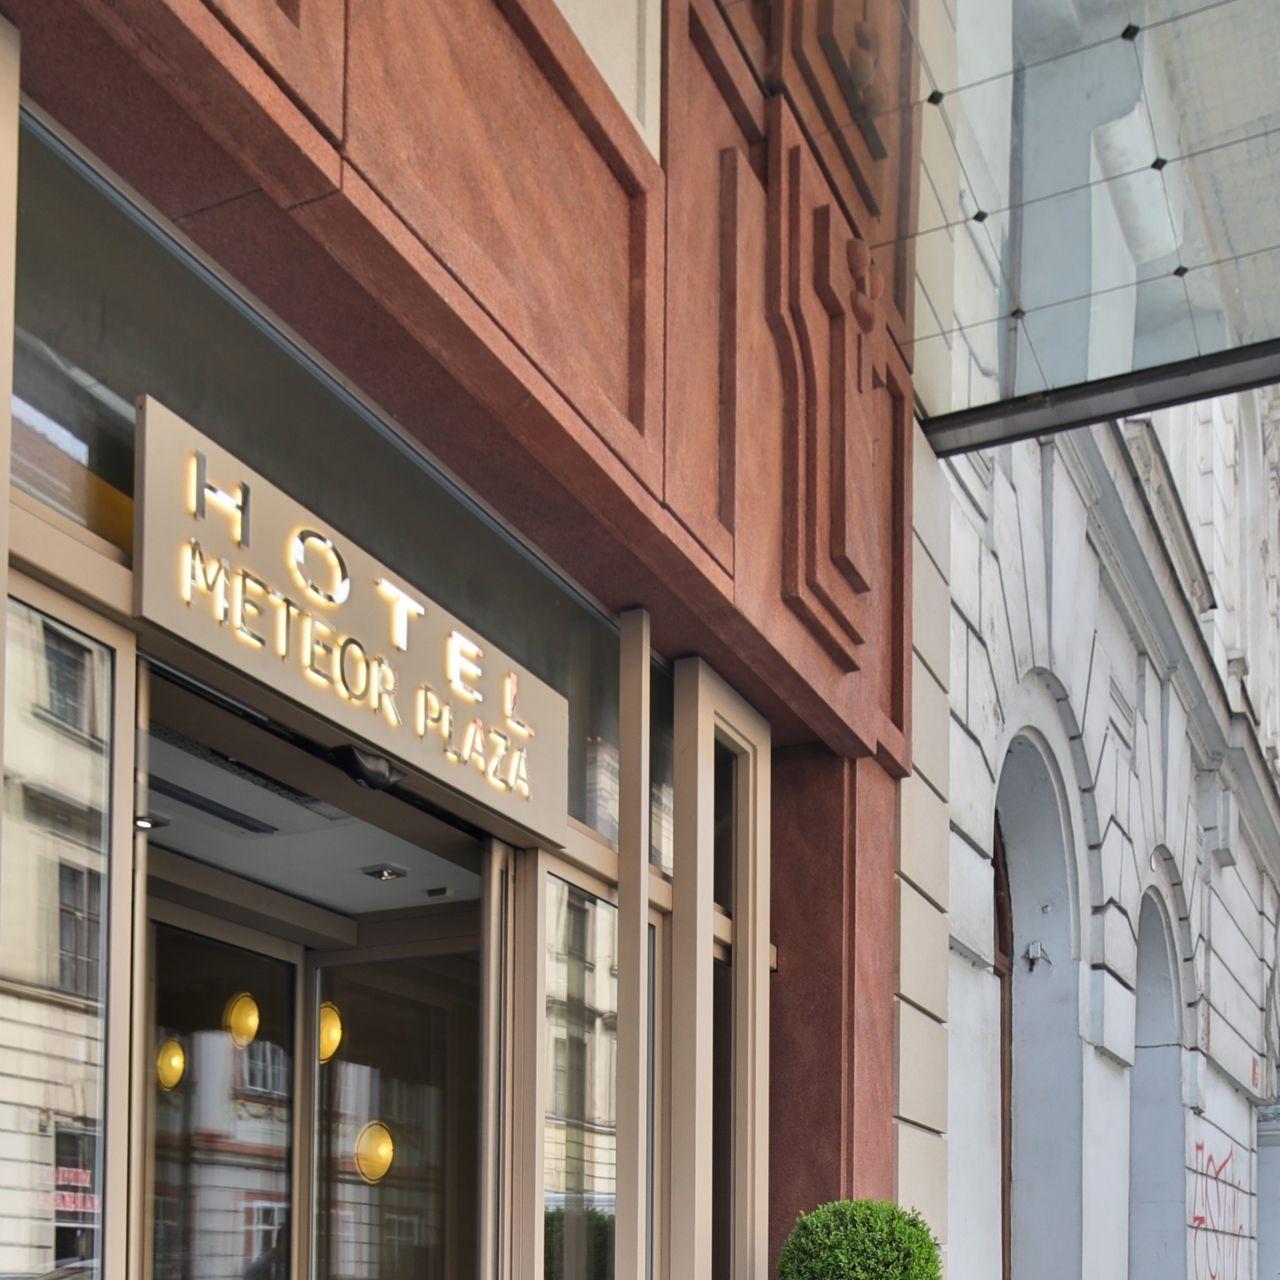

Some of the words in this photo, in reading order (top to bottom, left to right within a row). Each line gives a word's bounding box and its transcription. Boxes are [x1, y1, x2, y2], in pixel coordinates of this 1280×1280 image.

[181, 537, 404, 728] METEOR
[416, 684, 532, 801] PLAZA
[188, 449, 535, 738] HOTEL
